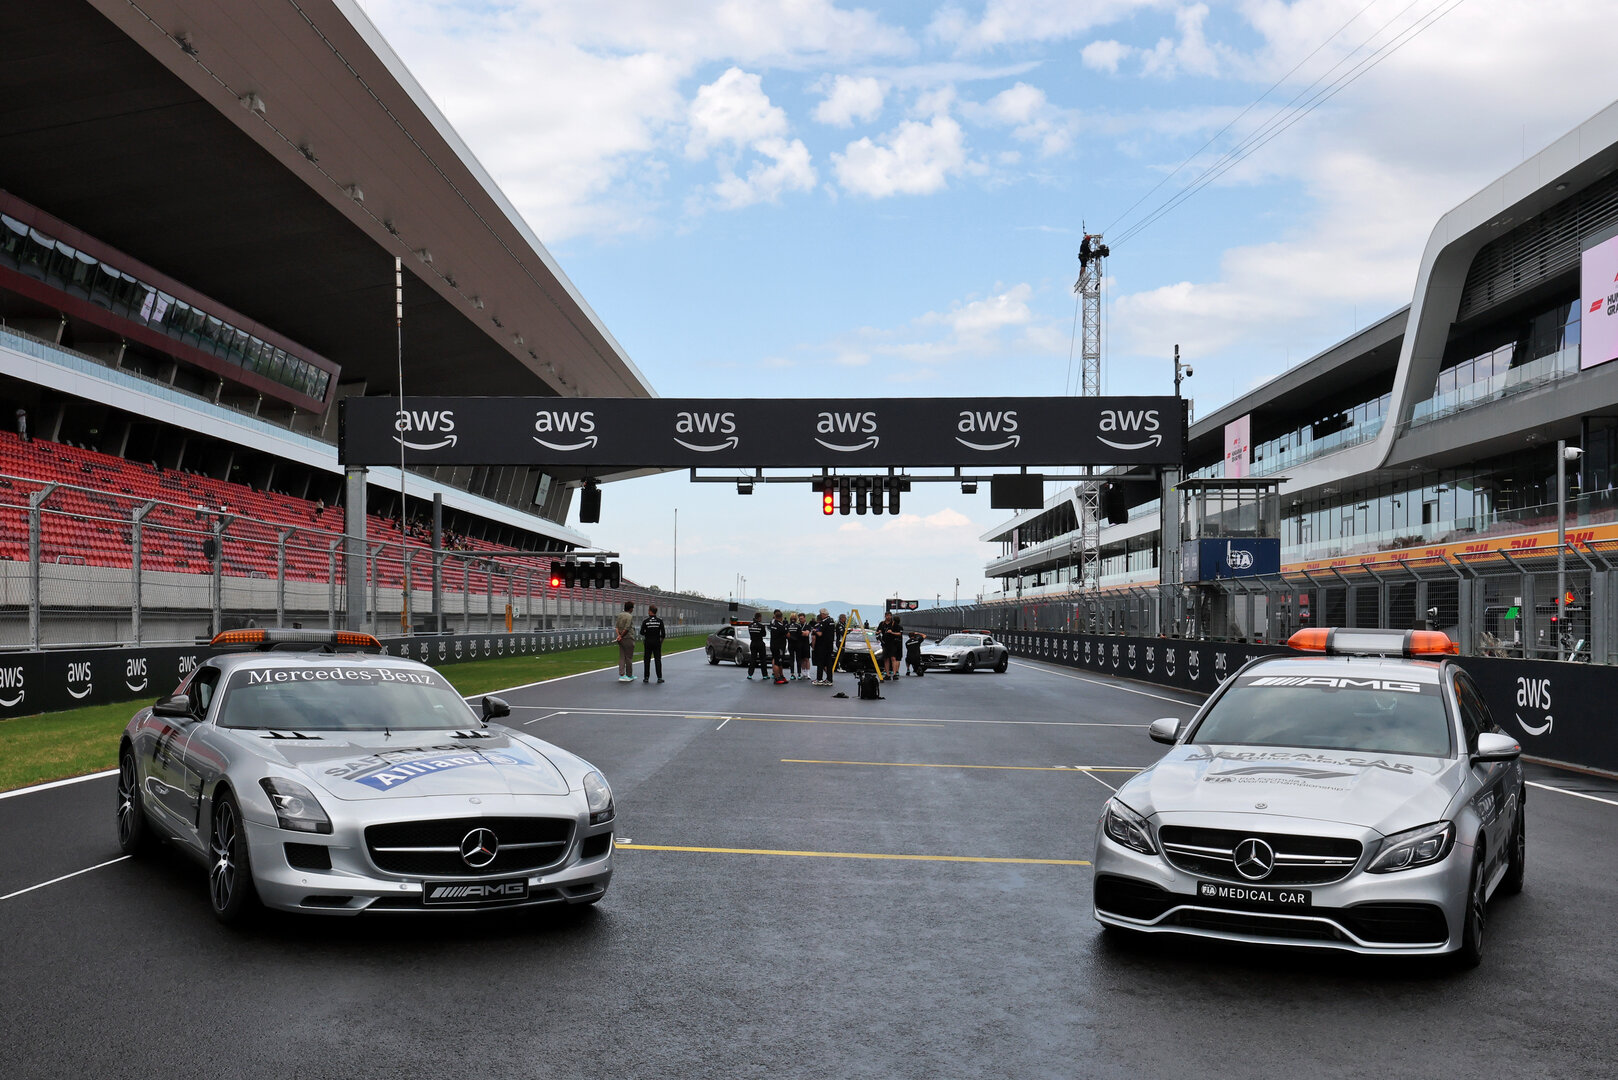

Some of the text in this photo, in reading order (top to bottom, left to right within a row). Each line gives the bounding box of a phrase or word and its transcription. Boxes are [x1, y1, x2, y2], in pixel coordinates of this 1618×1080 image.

[394, 410, 455, 432] aws
[535, 410, 595, 433] aws
[676, 411, 736, 434] aws
[817, 411, 877, 434] aws
[958, 410, 1018, 433] aws
[1099, 409, 1160, 432] aws
[179, 655, 197, 673] aws
[1166, 647, 1175, 664] aws
[1188, 650, 1199, 667] aws
[1215, 652, 1227, 670] aws
[67, 661, 92, 683] aws
[127, 658, 147, 677] aws
[248, 668, 435, 685] Mercedes-Benz
[1297, 677, 1421, 693] AMG
[1516, 676, 1552, 710] aws
[371, 756, 488, 786] Allianz
[1187, 751, 1415, 771] MEDICAL CAR
[462, 882, 524, 898] AMG
[1219, 886, 1275, 902] MEDICAL
[1279, 892, 1306, 904] CAR
